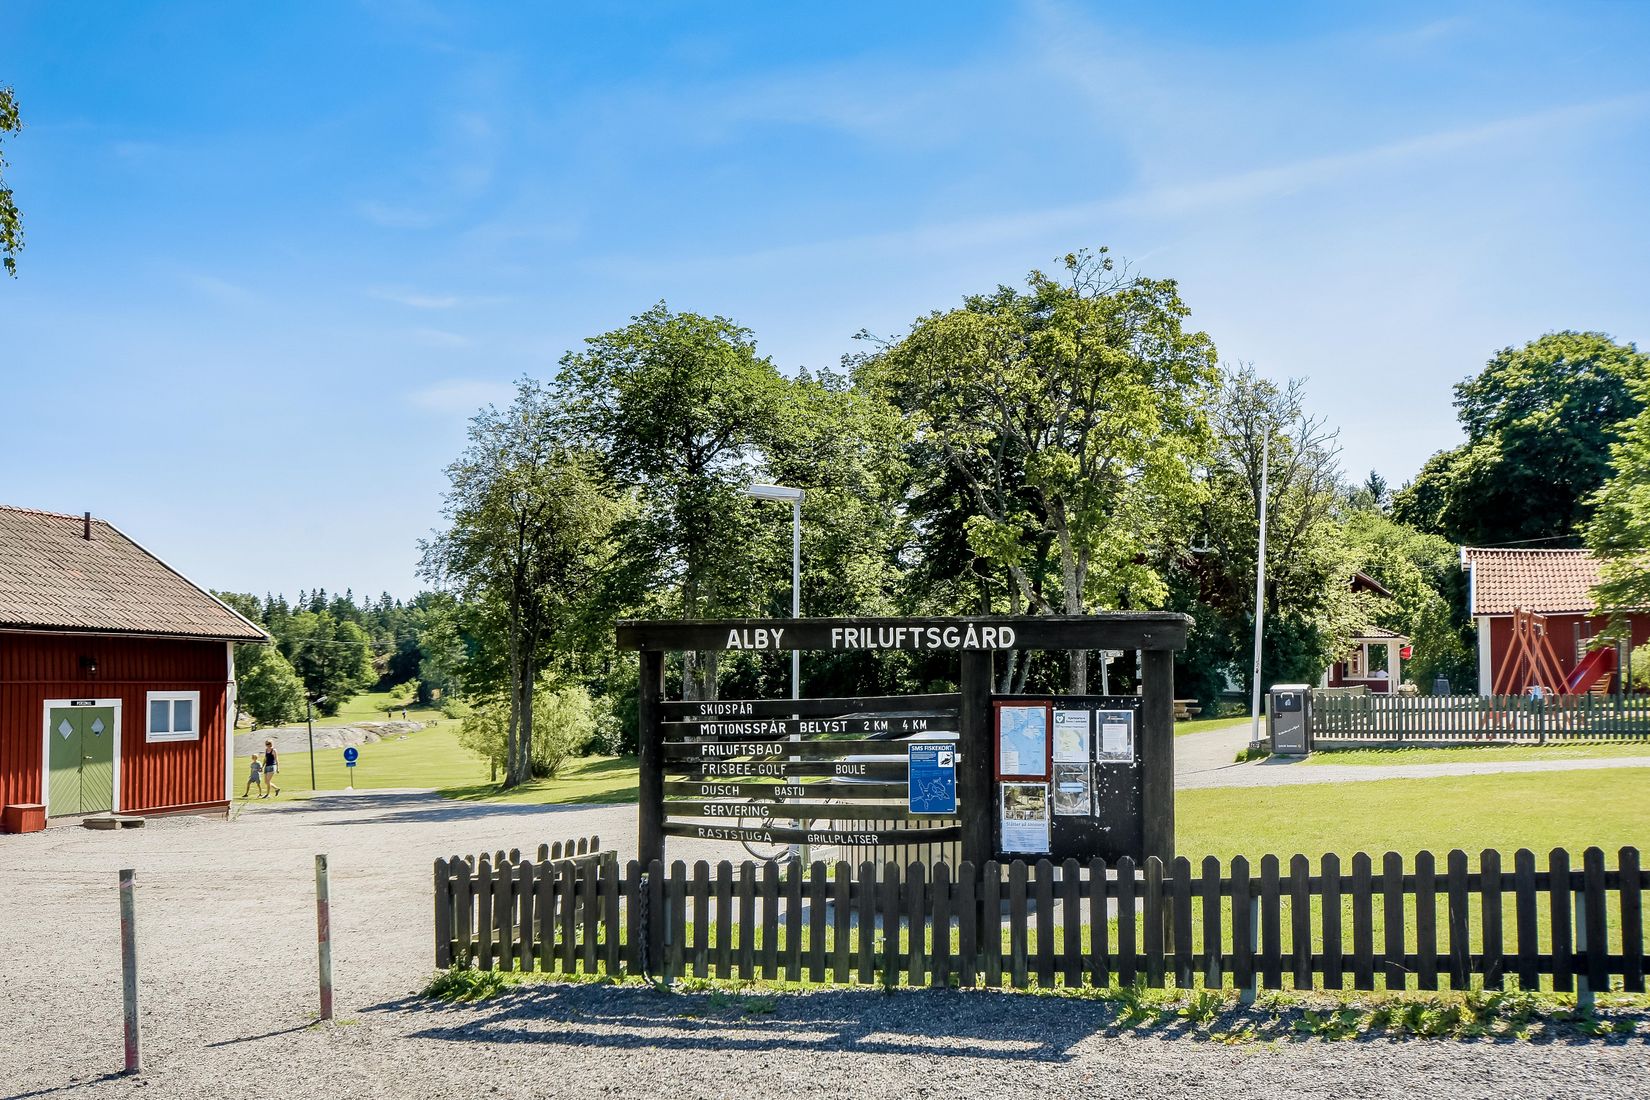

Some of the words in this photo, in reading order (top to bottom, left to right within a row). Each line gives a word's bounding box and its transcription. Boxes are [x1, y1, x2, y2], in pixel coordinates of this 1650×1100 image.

[726, 628, 784, 649] ALBY
[831, 623, 1016, 649] FRILUFTSGÅRD
[700, 702, 753, 715] SKIDSPÅR
[700, 720, 787, 735] MOTIONSSPÅR
[799, 721, 848, 733] BELYST
[863, 721, 870, 731] 2
[874, 720, 888, 730] KM
[902, 720, 909, 730] 4
[912, 720, 927, 730] KM
[702, 744, 783, 756] FRILUFTSBAD
[702, 763, 787, 775] FRISBEE-GOLF
[835, 764, 866, 775] BOULE
[701, 785, 740, 796] DUSCH
[774, 786, 805, 797] BASTU
[703, 805, 769, 817] SERVERING
[698, 827, 772, 842] RASTSTUGA
[807, 834, 879, 845] GRILLPLATSER
